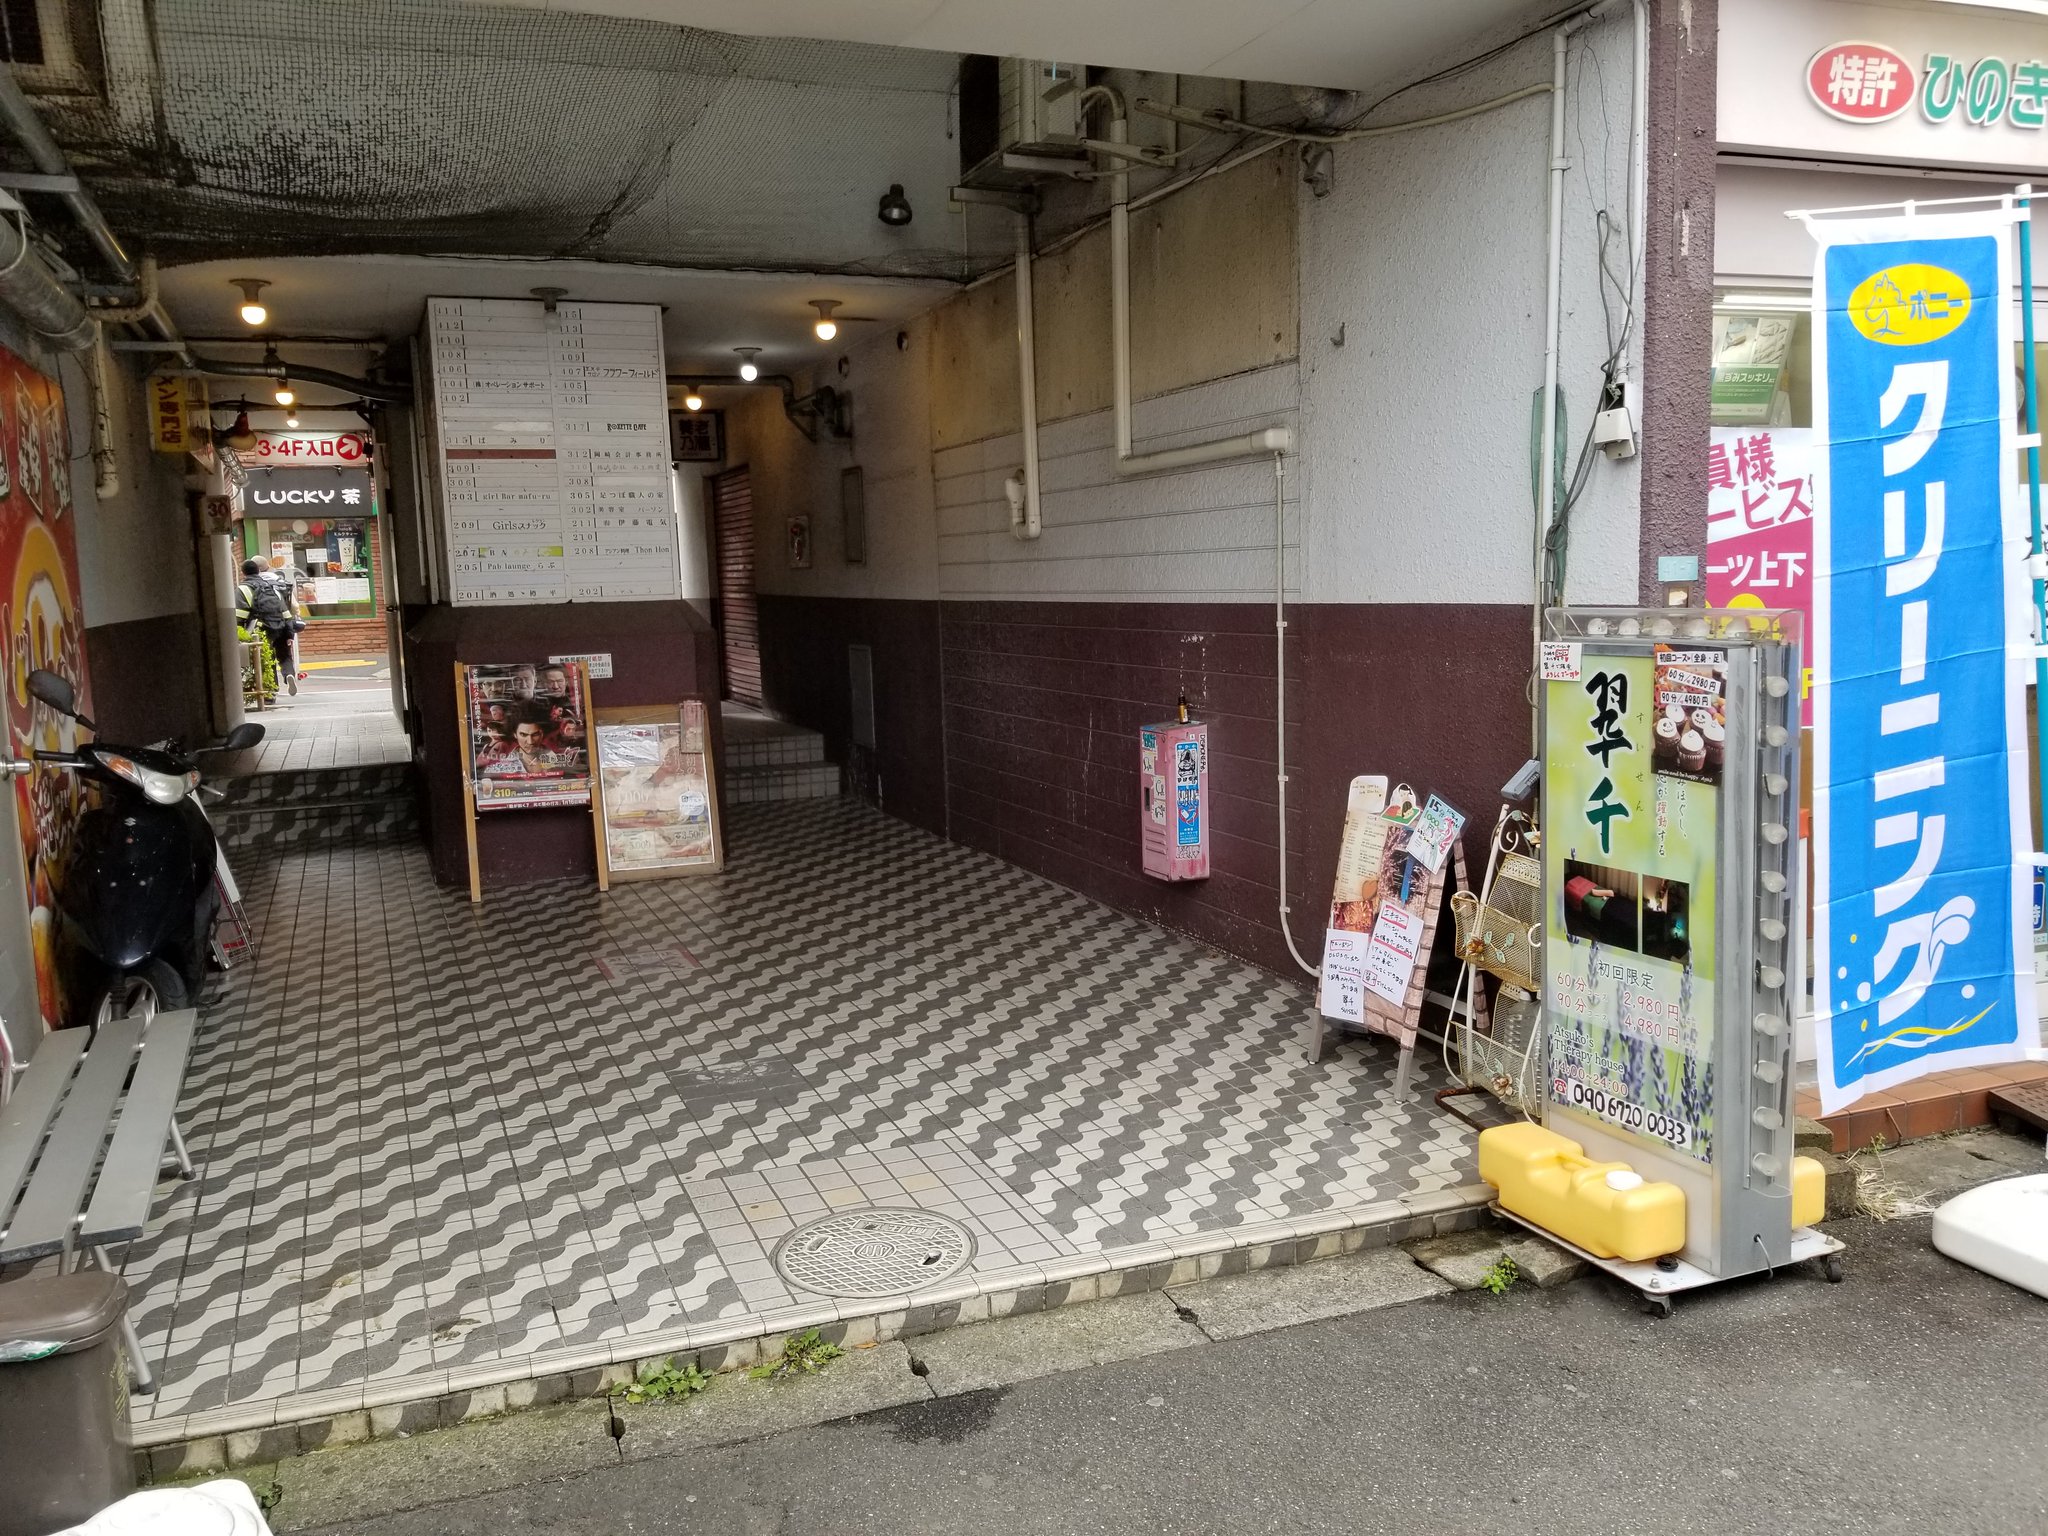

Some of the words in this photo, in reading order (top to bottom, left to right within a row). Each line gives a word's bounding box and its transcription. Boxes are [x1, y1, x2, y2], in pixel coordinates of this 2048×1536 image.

[1827, 53, 1899, 108] 特許
[1909, 289, 1964, 320] ポニー
[253, 490, 335, 505] LUCKY
[1873, 360, 1949, 1027] クリーニング
[1598, 960, 1654, 991] 初回限定
[1554, 1025, 1594, 1048] Atsuko's
[1554, 1038, 1593, 1064] Therapy
[1595, 1053, 1624, 1073] house
[1573, 1083, 1605, 1113] 090
[1607, 1097, 1643, 1128] 6720
[1646, 1112, 1687, 1146] 0033
